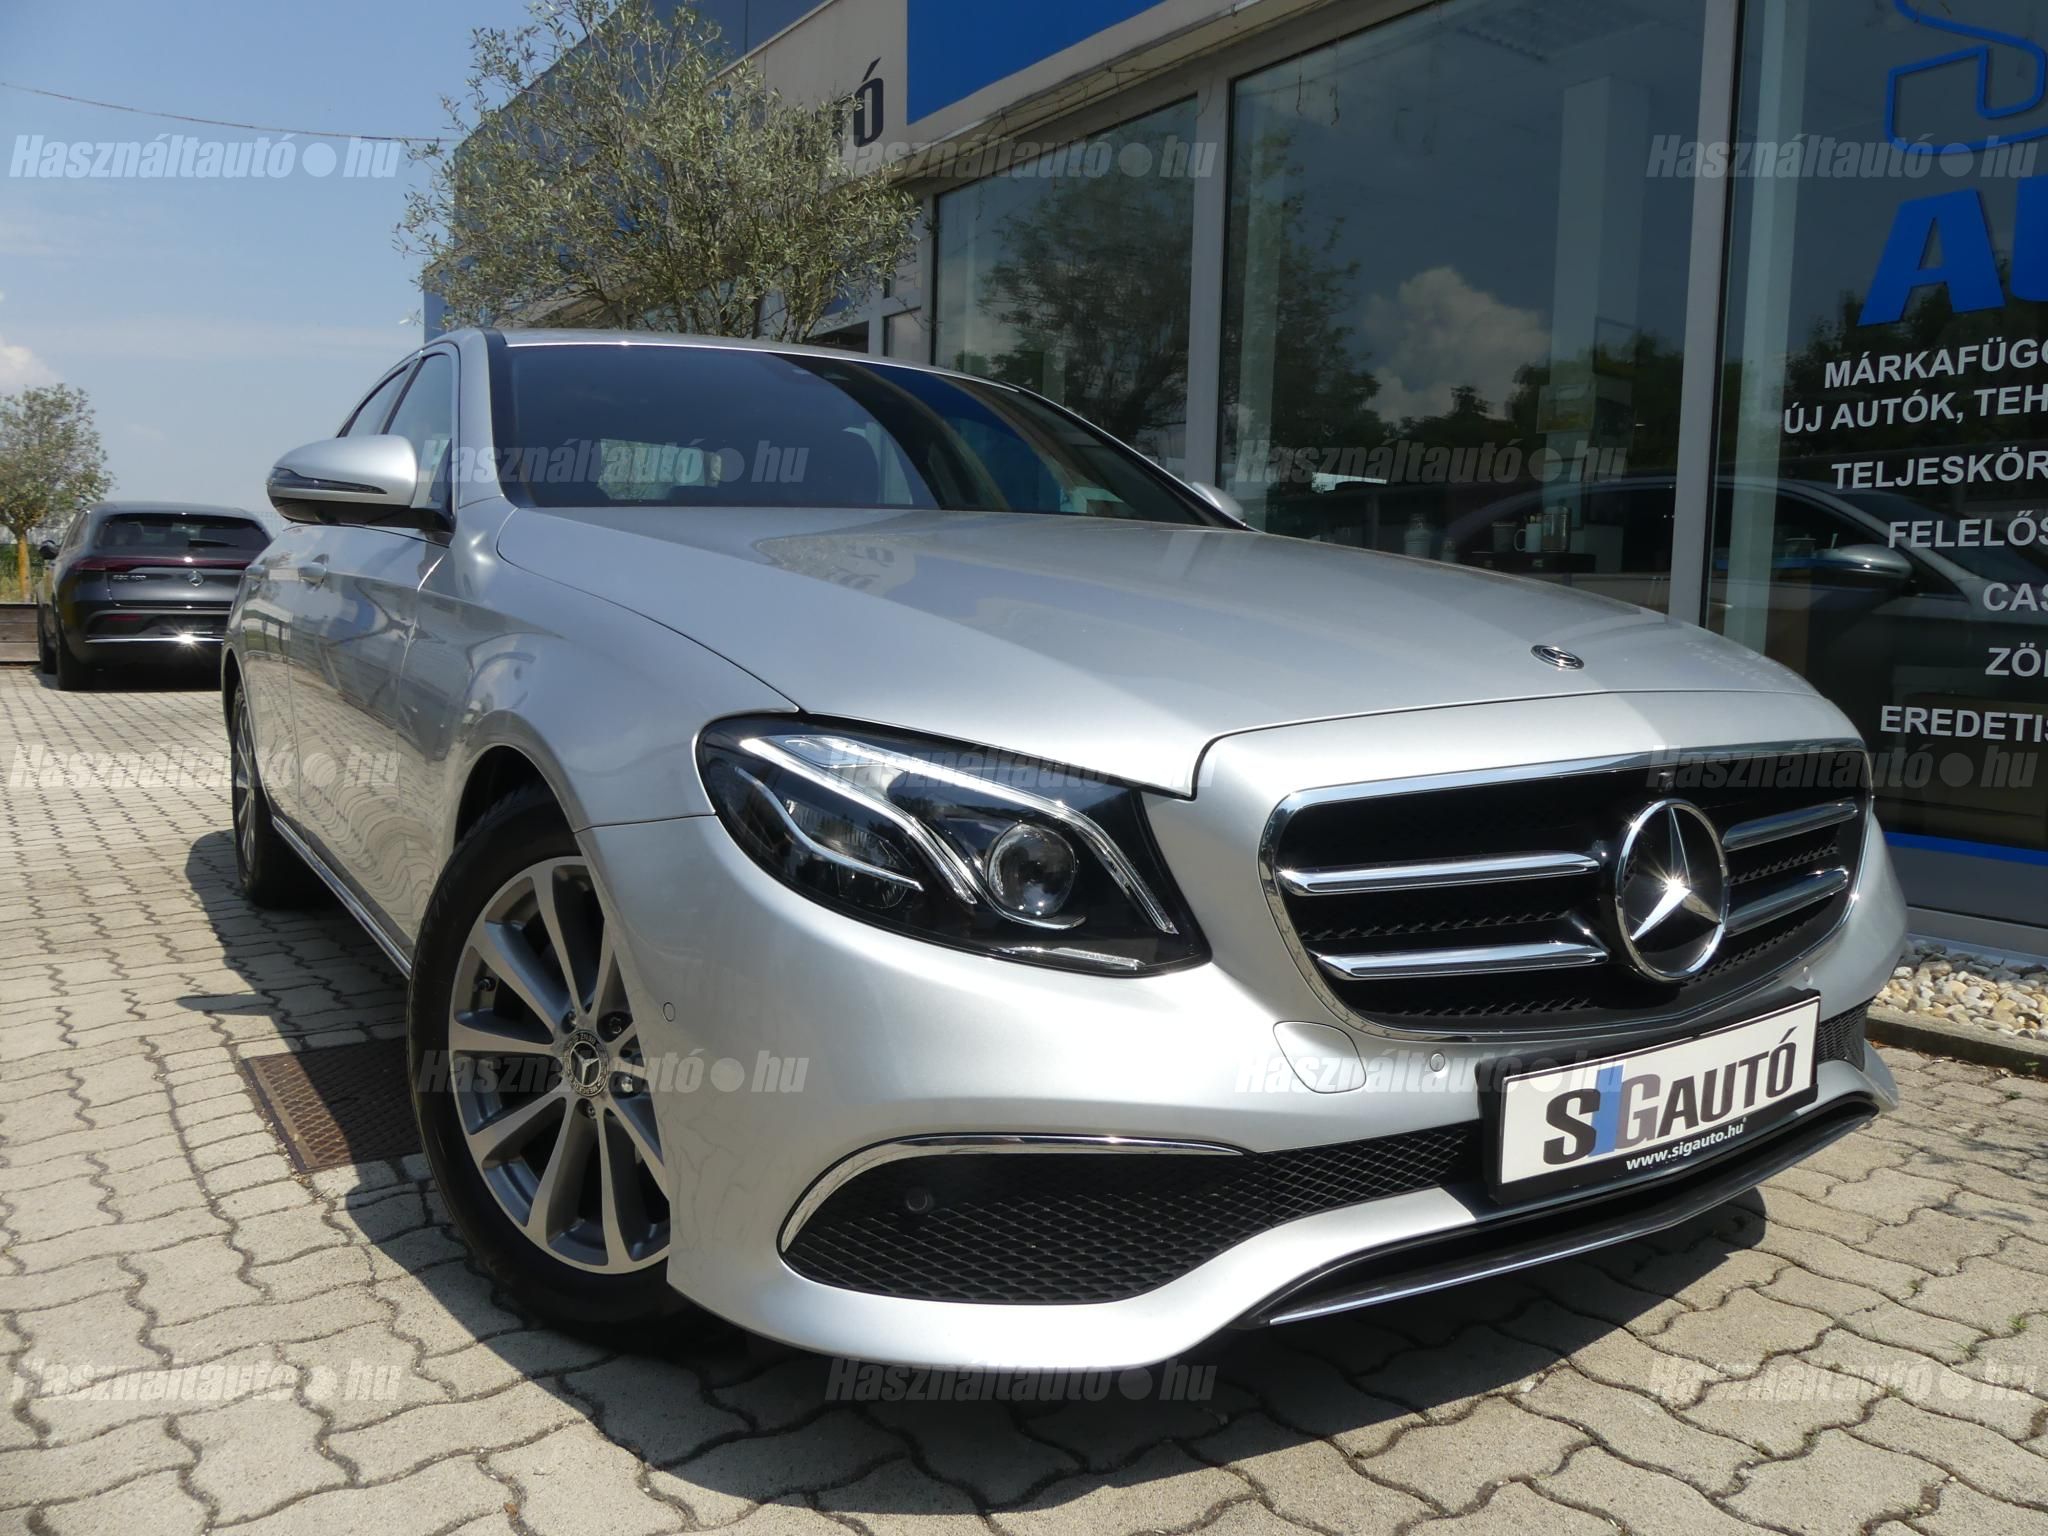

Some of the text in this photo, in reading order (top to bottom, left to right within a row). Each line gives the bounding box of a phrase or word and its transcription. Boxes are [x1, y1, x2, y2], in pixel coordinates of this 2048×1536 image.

[1824, 336, 2048, 389] MÁRKAFÜG
[1784, 402, 1823, 434] ÚJ
[1831, 389, 1964, 430] AUTÓK,
[1983, 582, 2048, 612] CA
[1985, 642, 2048, 677] ZÖ
[1880, 705, 2048, 744] EREDETI
[1543, 1026, 1798, 1165] SIGAUTÓ
[1625, 1122, 1745, 1171] www.sigauto.hu
